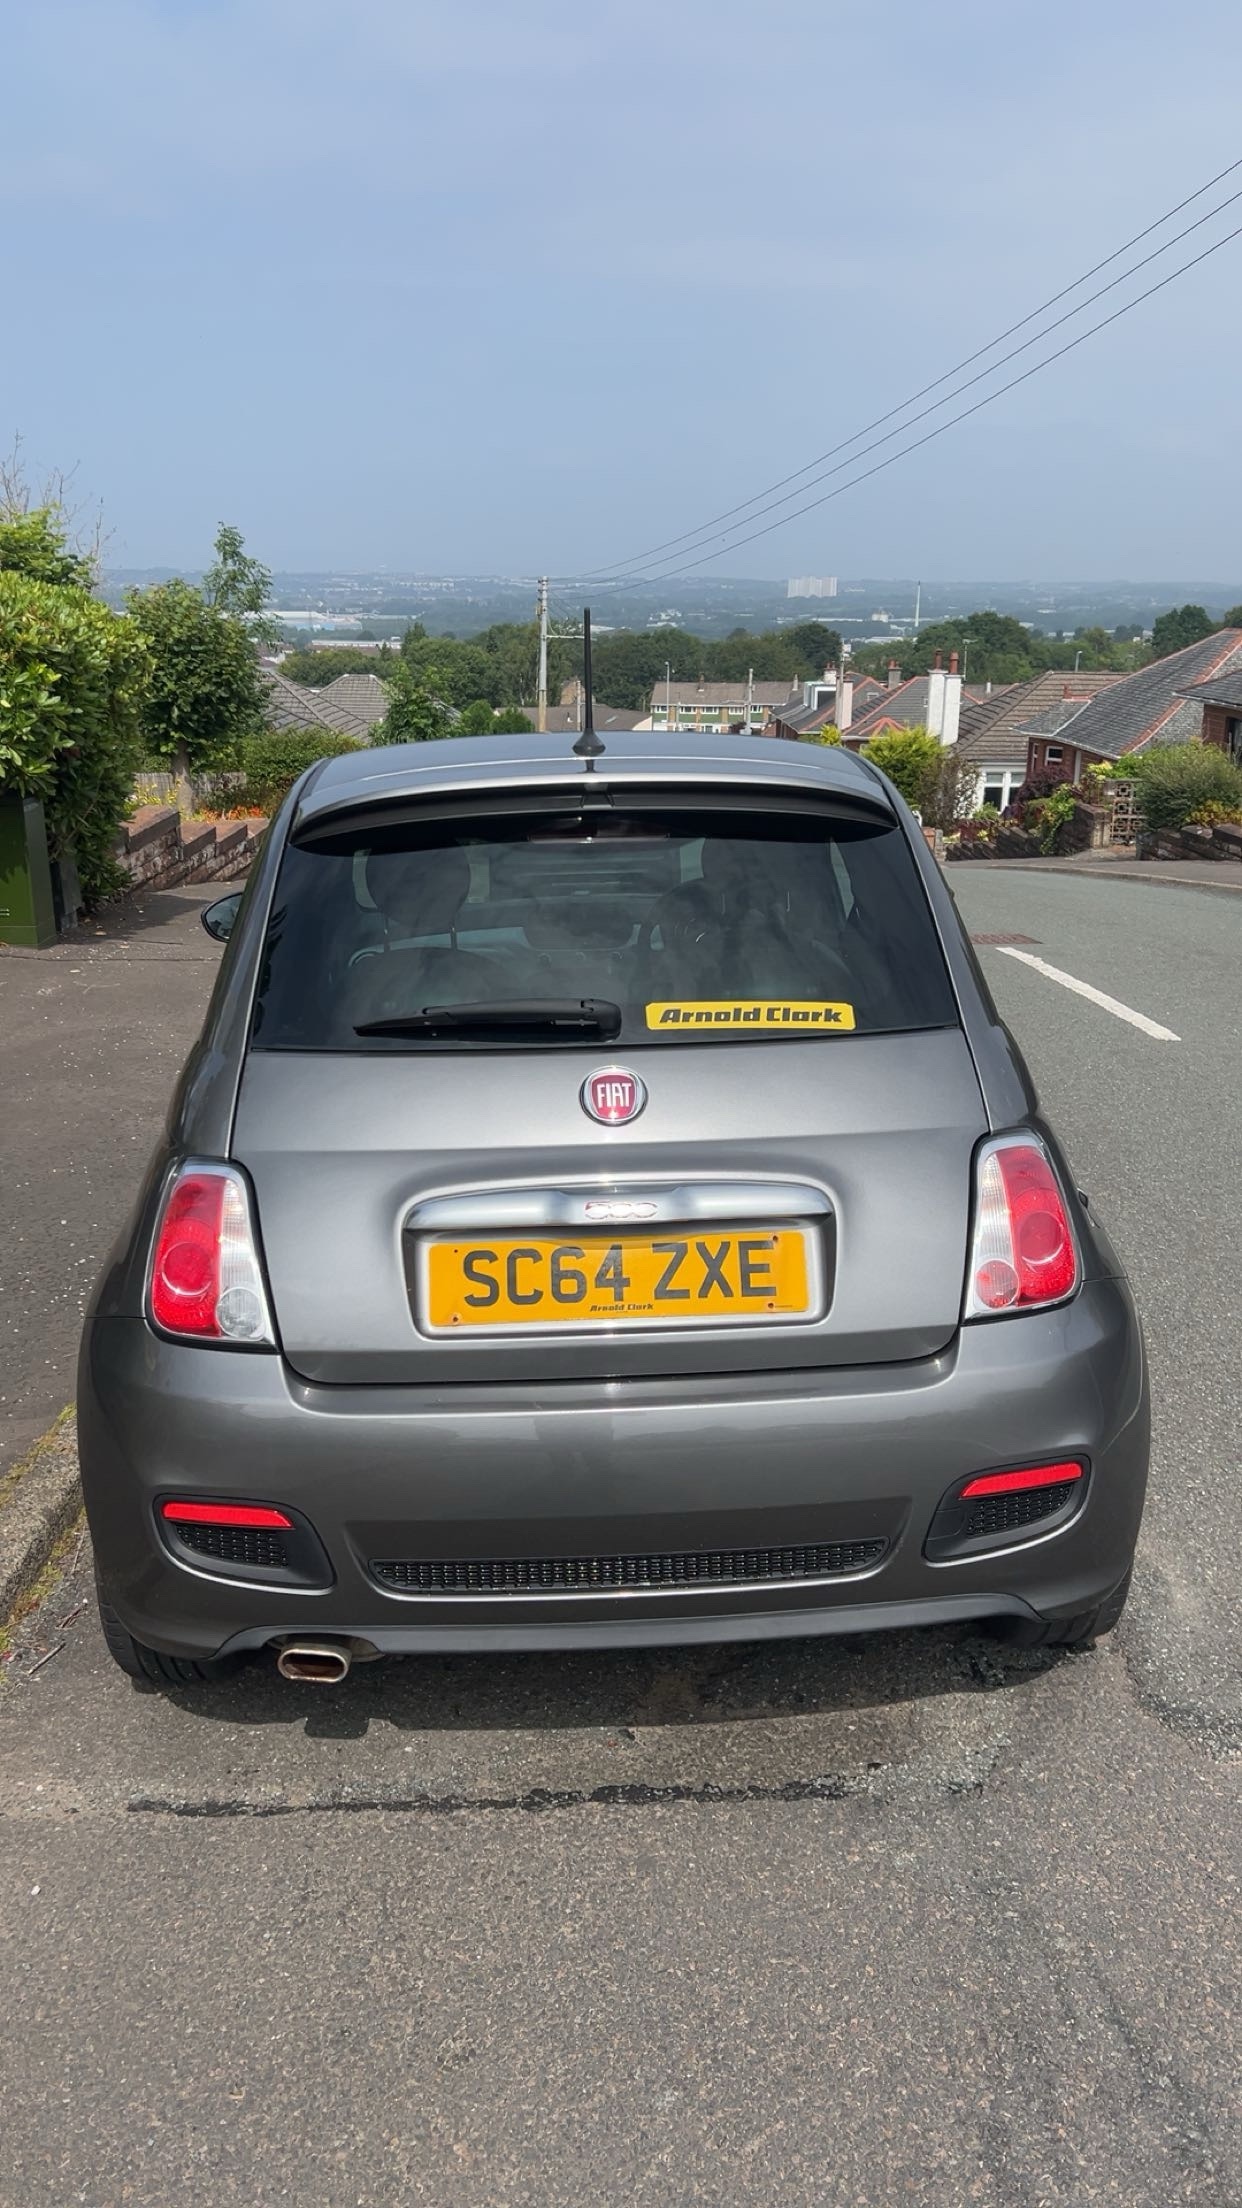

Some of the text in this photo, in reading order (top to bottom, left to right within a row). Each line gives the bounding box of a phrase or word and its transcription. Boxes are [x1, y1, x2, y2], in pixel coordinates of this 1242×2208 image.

[659, 1007, 843, 1024] Arnold Clark
[596, 1082, 632, 1108] FIAT
[584, 1200, 658, 1220] 500
[463, 1240, 777, 1307] SC64 ZXE
[590, 1304, 625, 1312] Arnold
[627, 1303, 654, 1311] Clark
